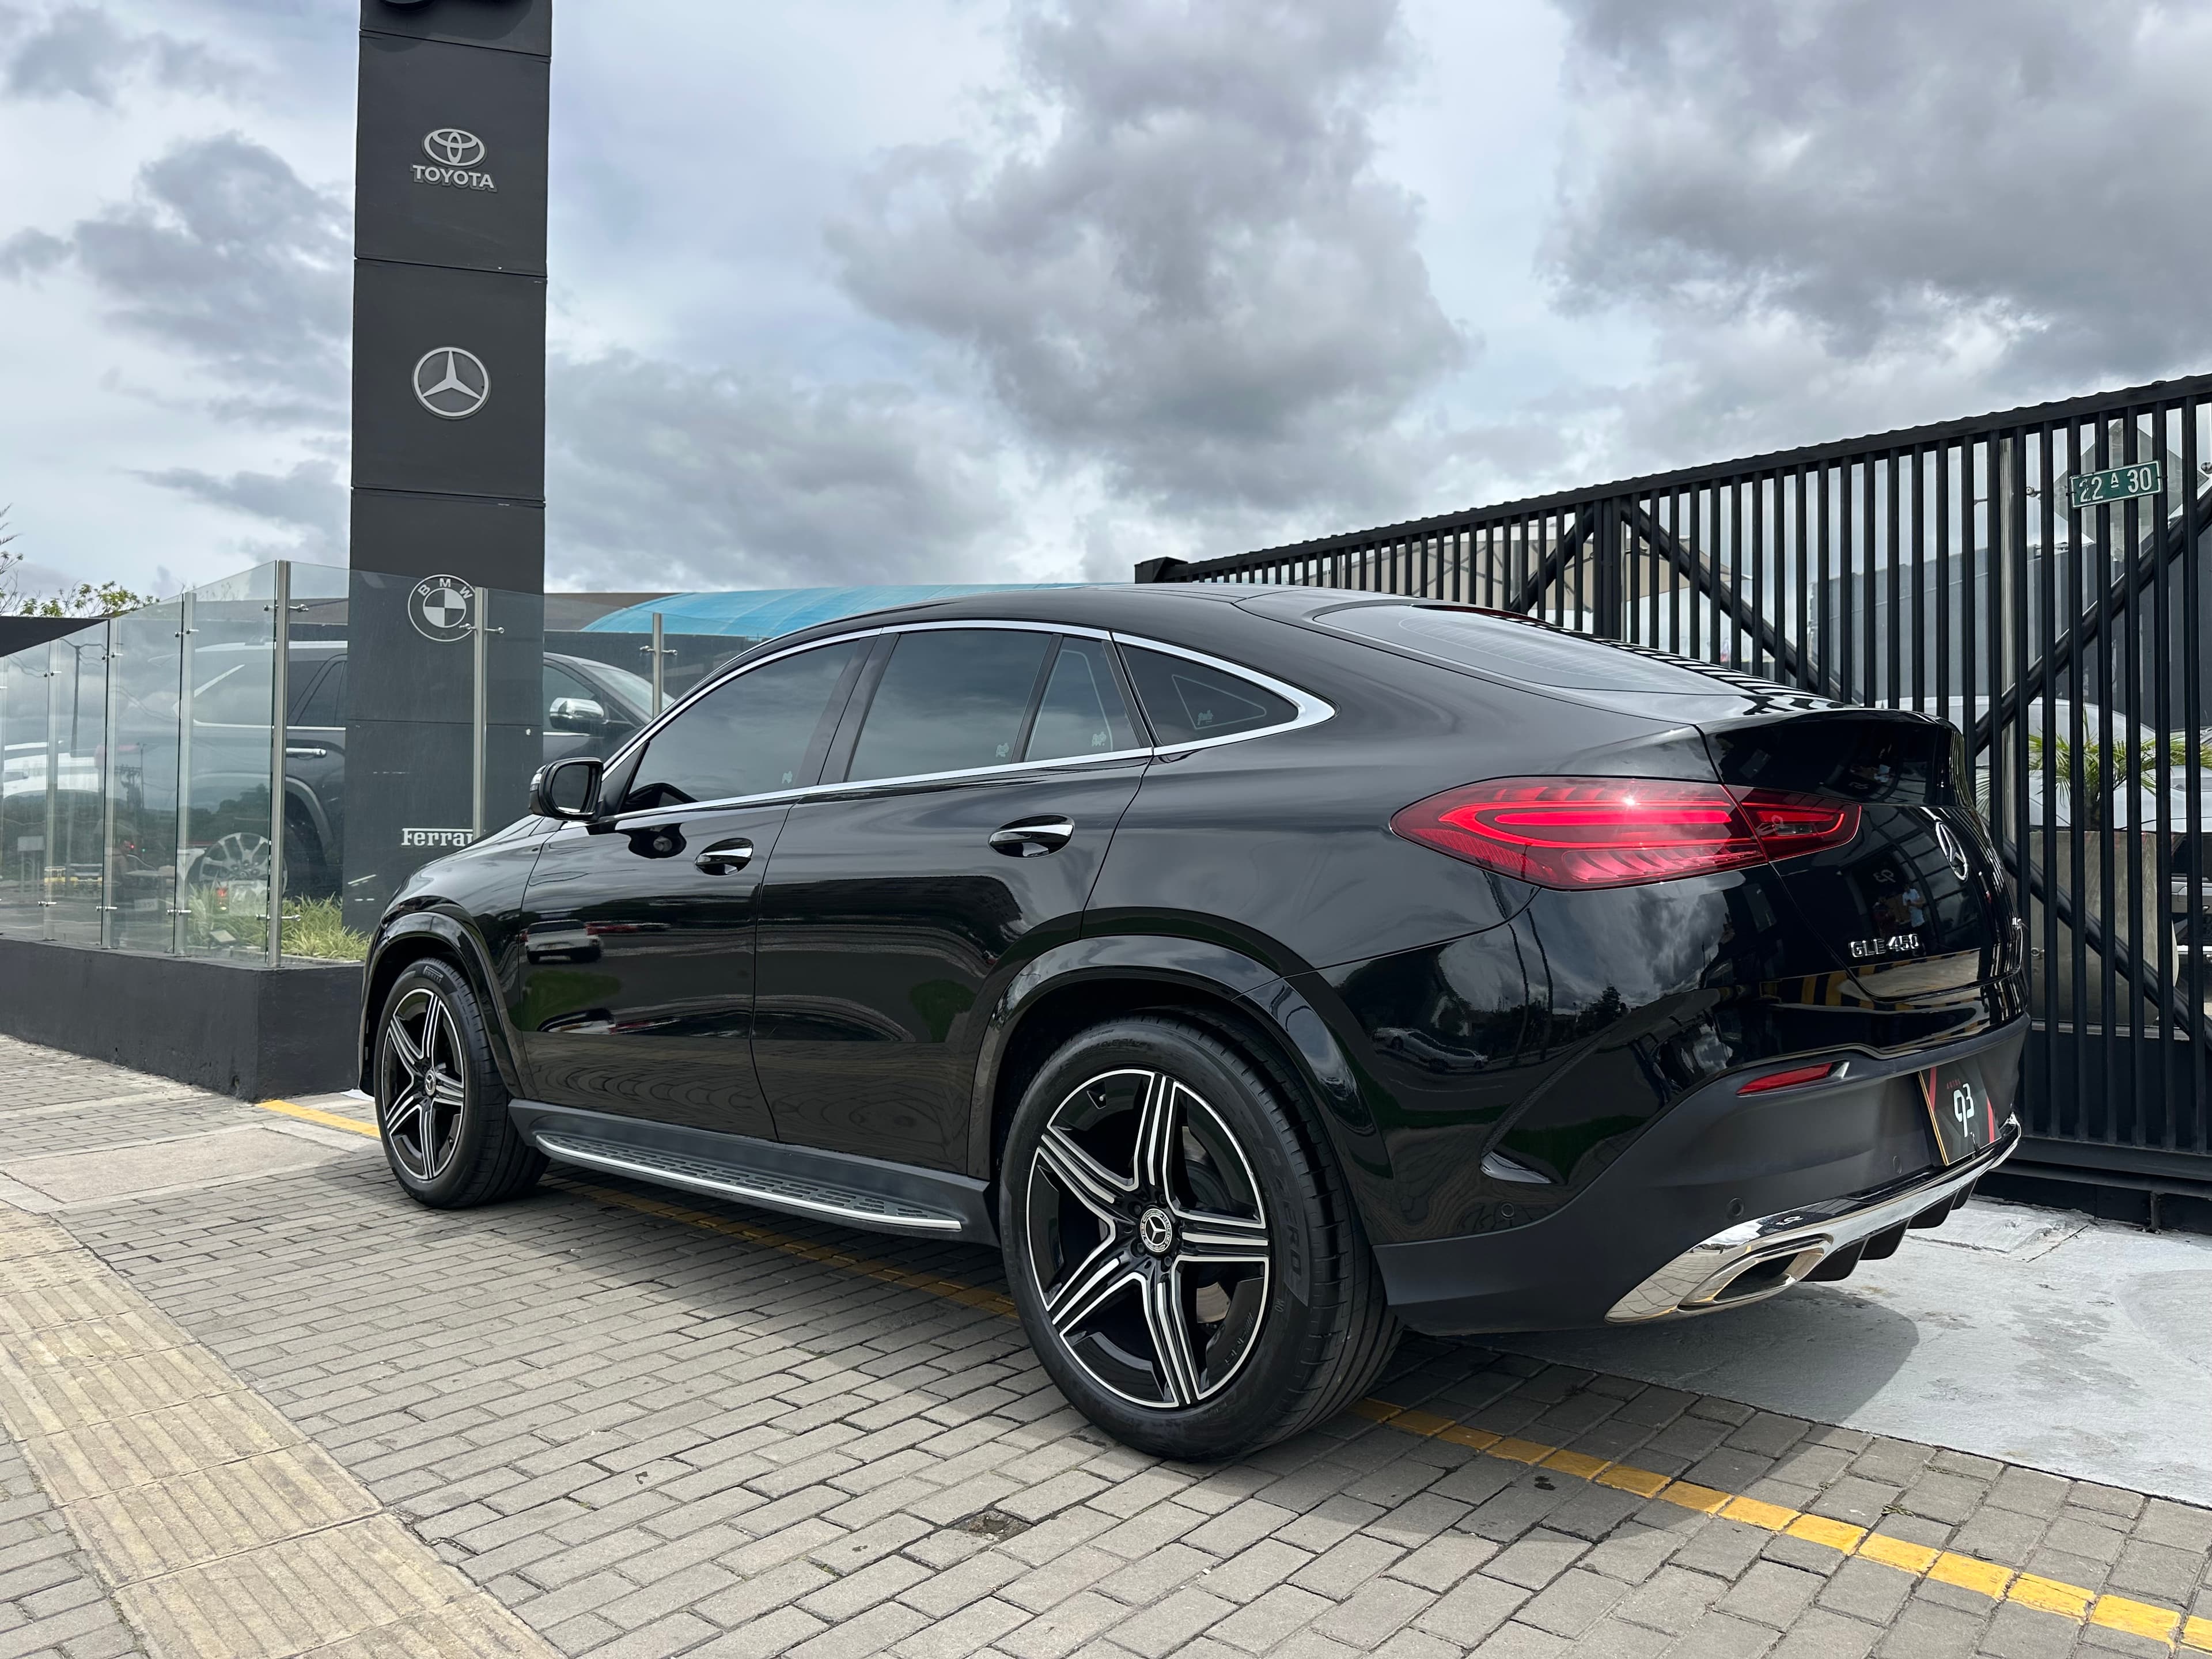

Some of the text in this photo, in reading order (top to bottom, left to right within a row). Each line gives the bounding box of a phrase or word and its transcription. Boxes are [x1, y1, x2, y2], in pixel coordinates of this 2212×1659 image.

[412, 165, 495, 189] TOYOTA
[2079, 477, 2103, 503] 22
[2127, 467, 2152, 493] 30
[417, 578, 474, 599] BMW
[1849, 934, 1919, 957] GLE 450
